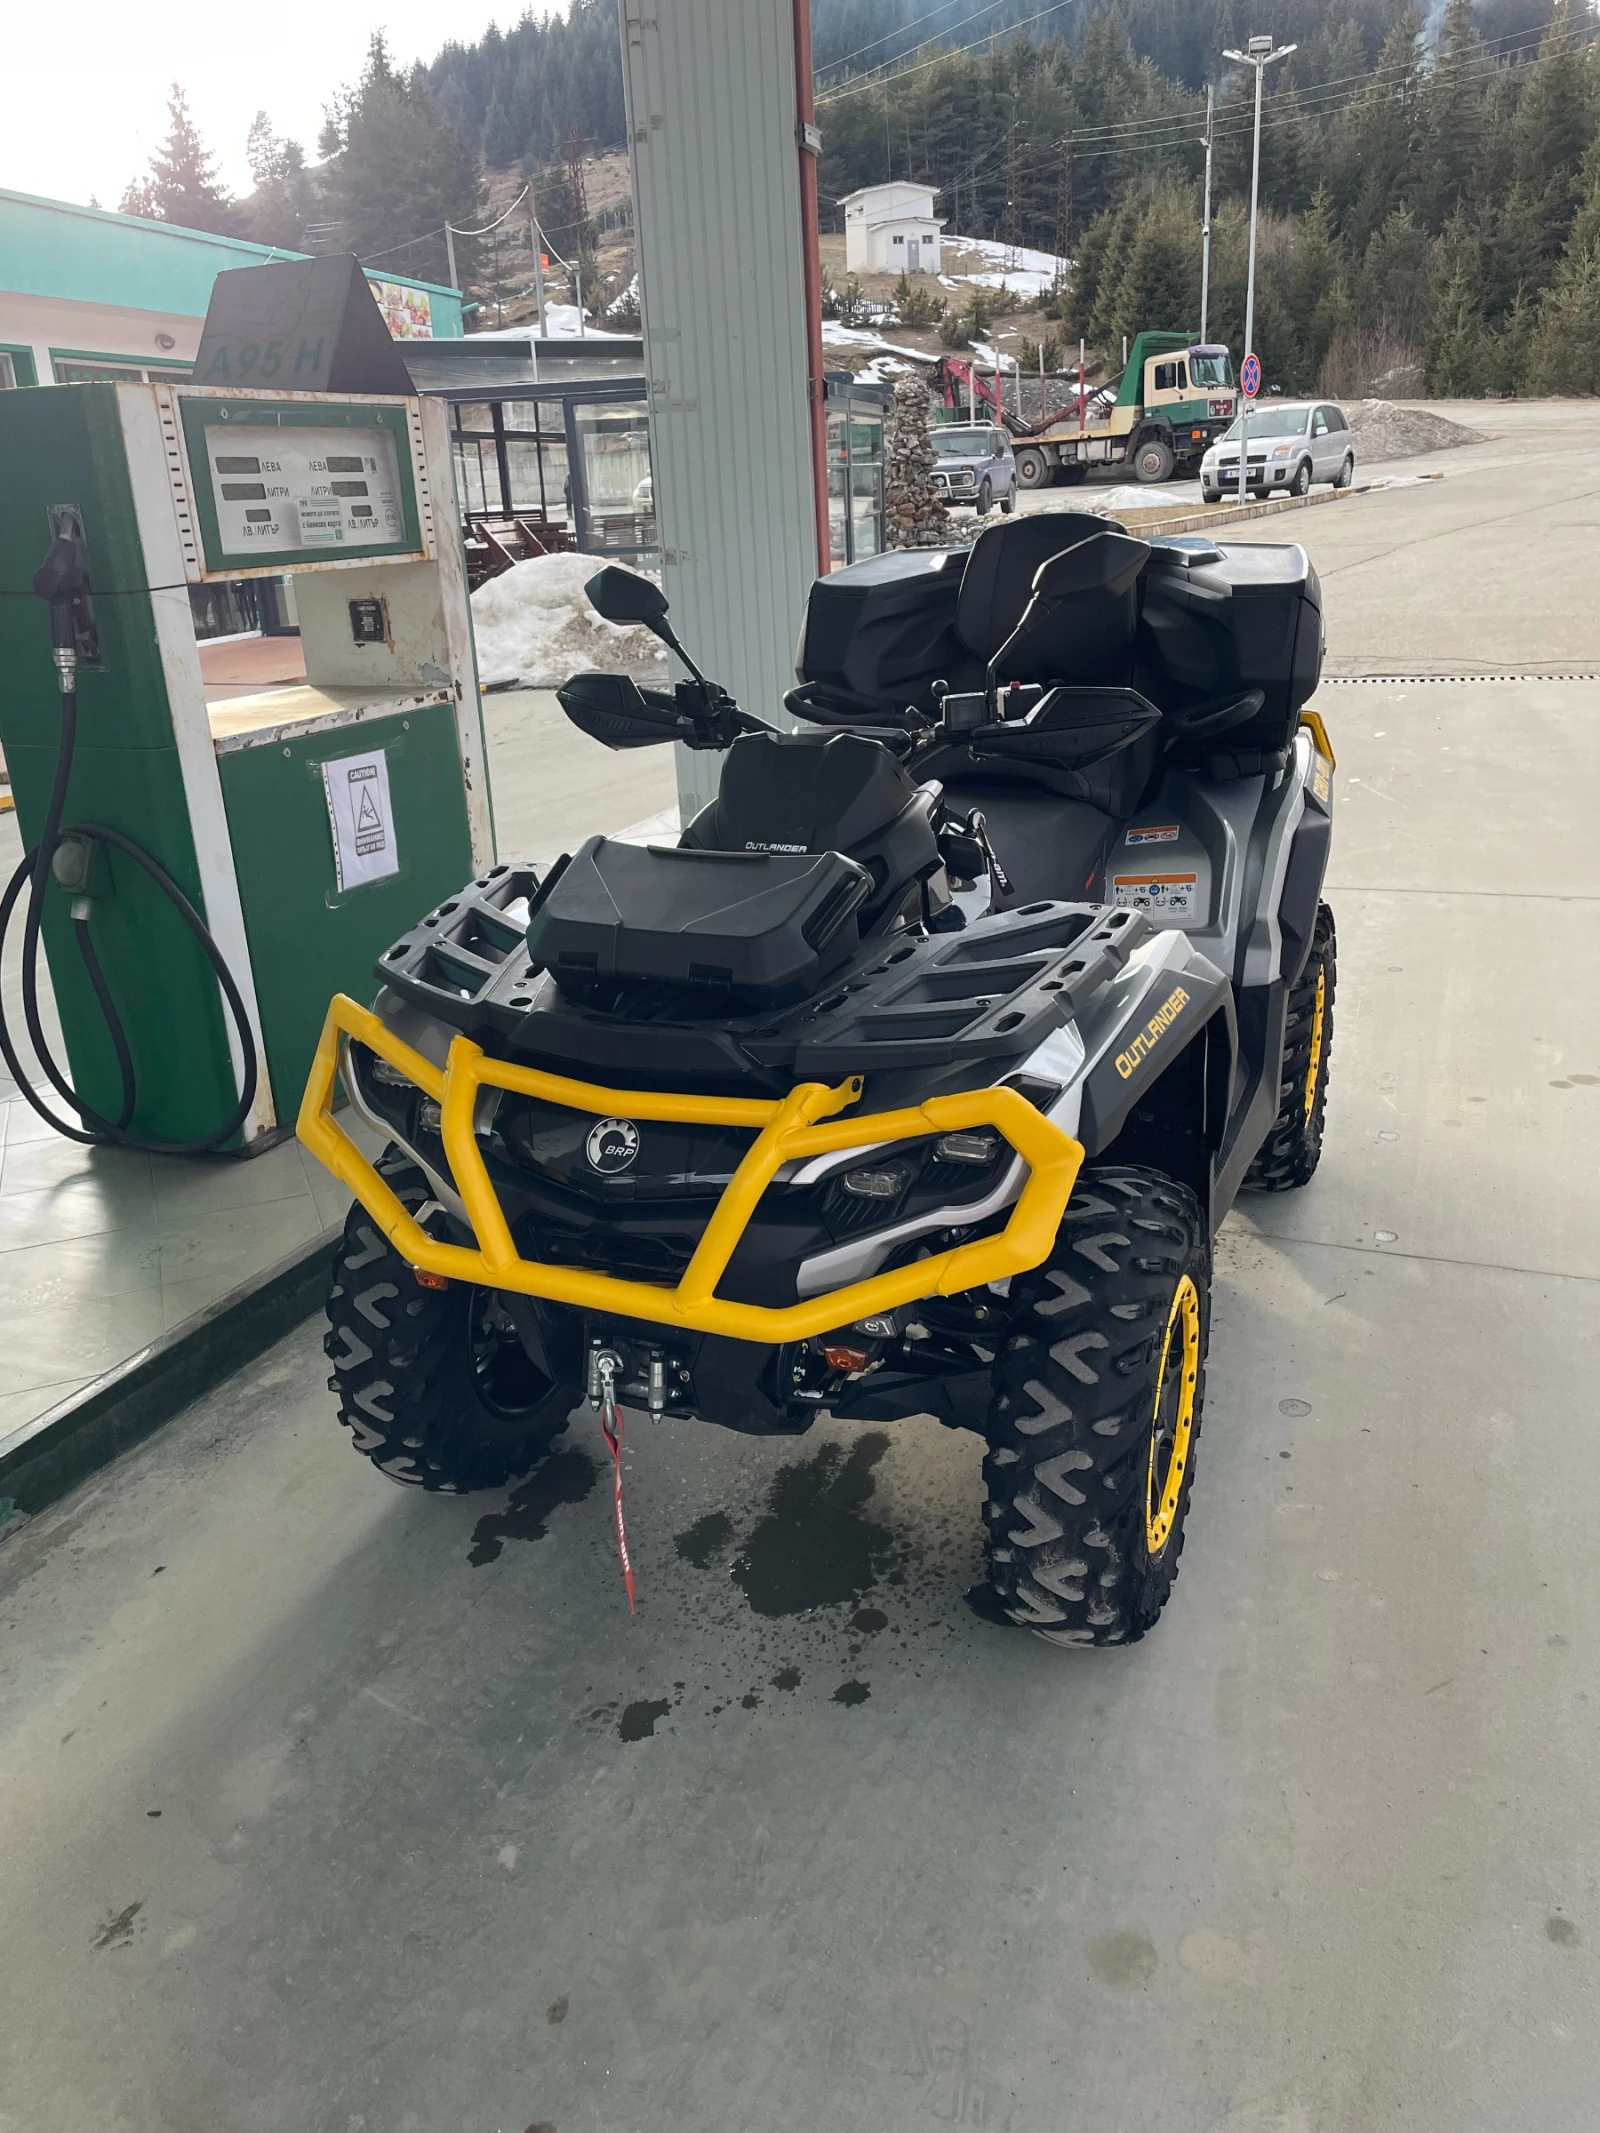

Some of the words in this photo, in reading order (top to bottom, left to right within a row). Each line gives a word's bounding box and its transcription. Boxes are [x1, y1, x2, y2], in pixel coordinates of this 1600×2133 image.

[261, 461, 281, 472] ЛЕВА
[308, 460, 327, 471] ЛЕВА
[266, 487, 290, 497] ЛИТРИ
[745, 841, 808, 853] OUTLANDER
[1114, 985, 1191, 1079] OUTLANDER
[604, 1145, 635, 1157] BRP
